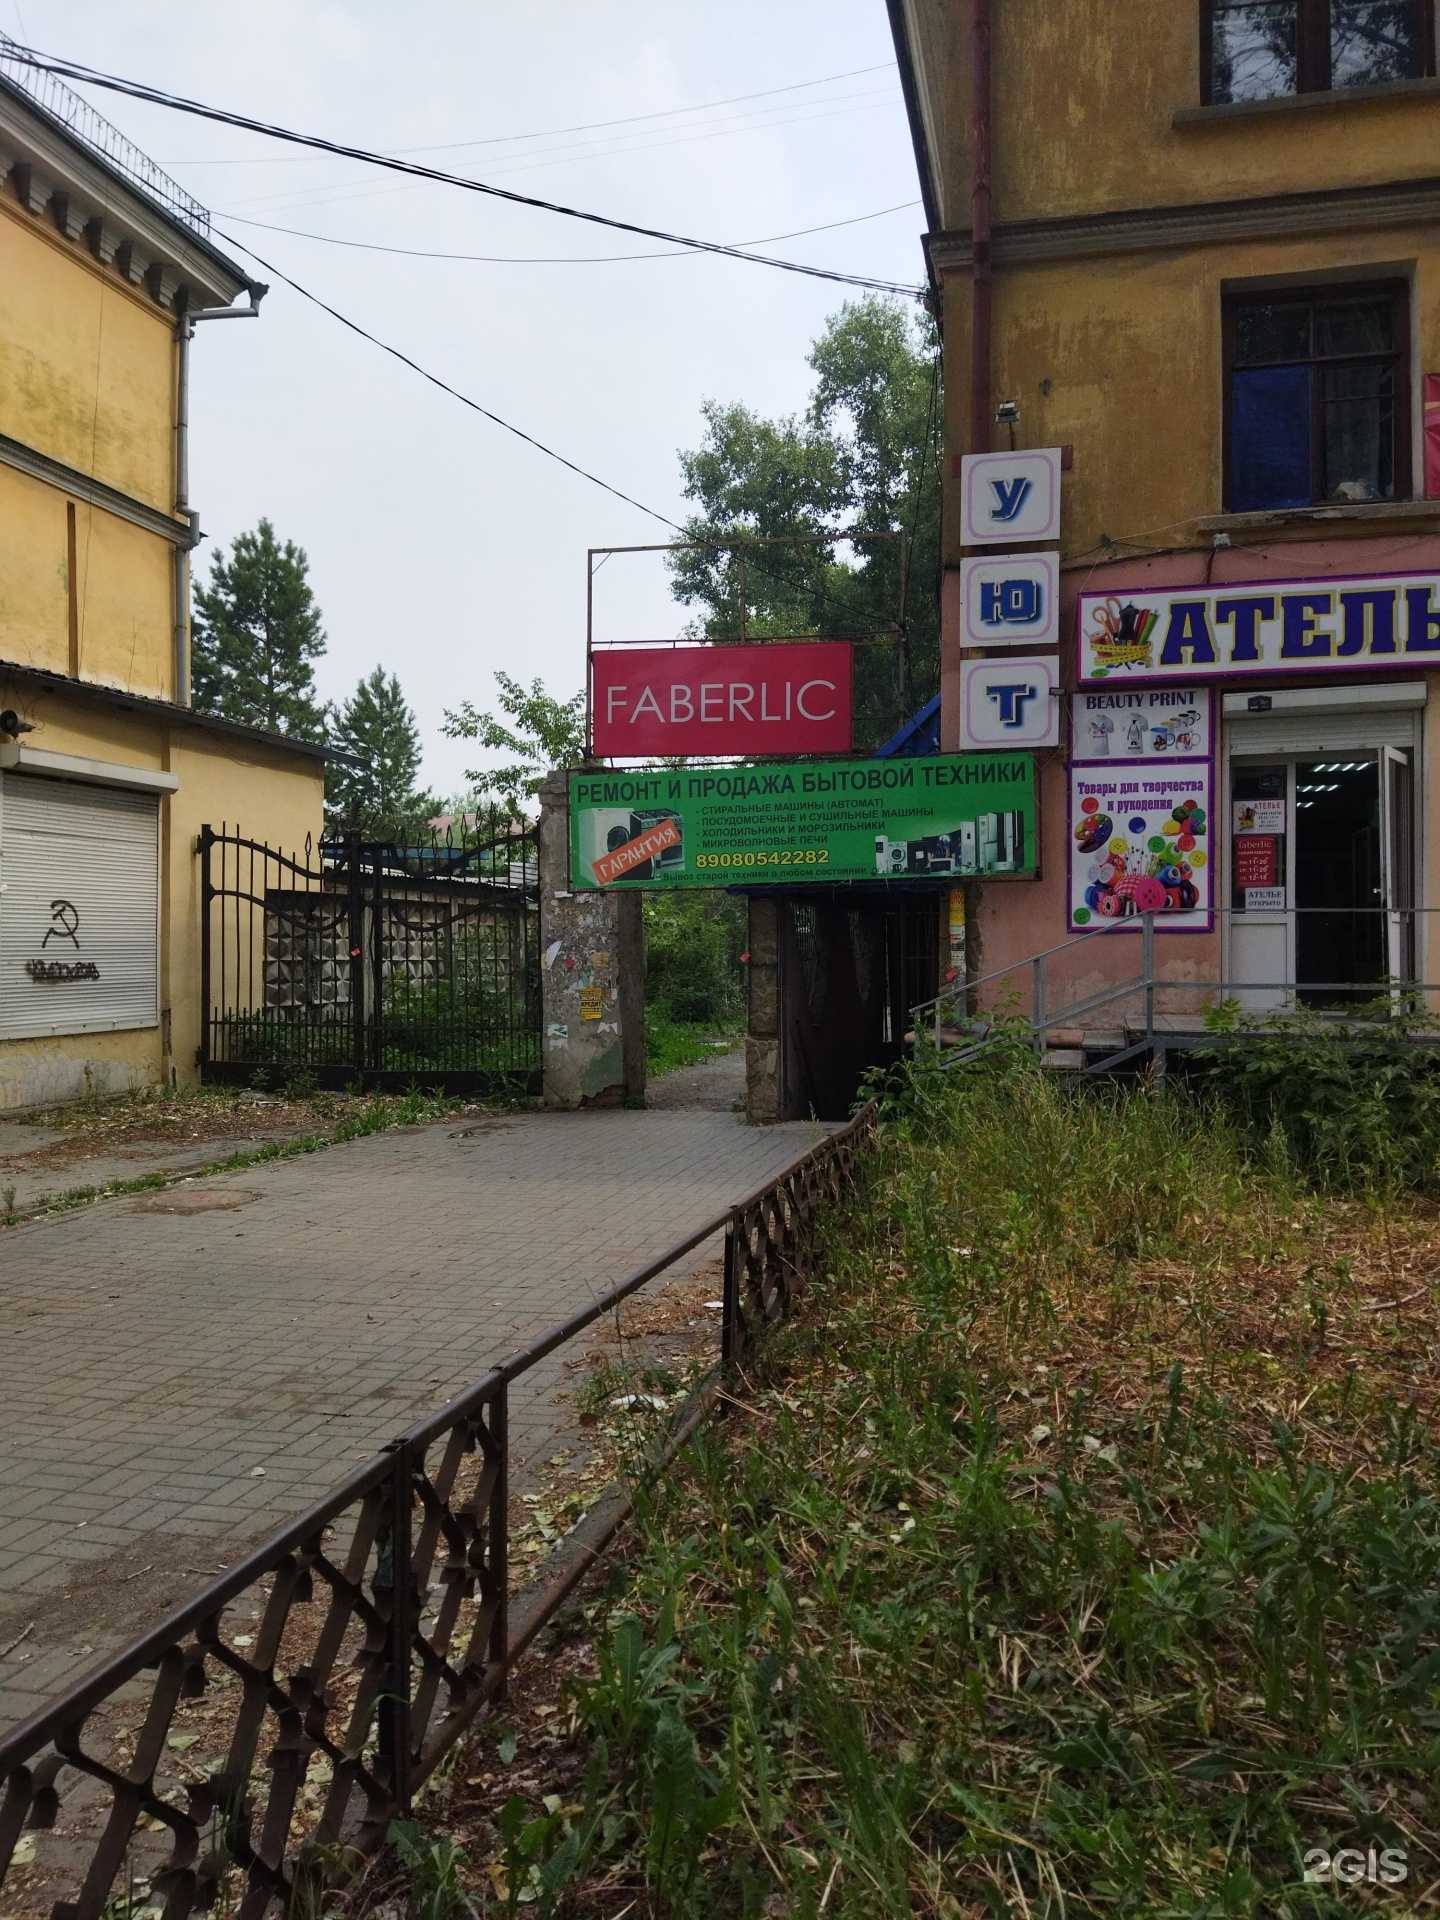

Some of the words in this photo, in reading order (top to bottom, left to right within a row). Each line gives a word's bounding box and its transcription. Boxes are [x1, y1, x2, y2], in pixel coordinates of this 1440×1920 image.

[606, 679, 838, 724] FABERLIC
[1086, 694, 1145, 710] BEAUTY
[1150, 691, 1197, 707] PRINT
[577, 780, 662, 803] РЕМОНТ
[668, 779, 681, 799] И
[688, 774, 795, 800] ПРОДАЖА
[802, 763, 914, 793] БЫТОВОЙ
[921, 761, 1027, 787] ТЕХНИКИ
[1077, 782, 1117, 797] Товары
[1120, 782, 1139, 794] для
[1142, 780, 1204, 795] творчества
[702, 803, 771, 815] СТИРАЛЬНЫЕ
[774, 800, 825, 812] МАШИНЫ
[1117, 800, 1173, 813] рукоделия
[702, 814, 796, 826] ПОСУДОМОЕЧНЫЕ
[800, 812, 806, 821] И
[809, 809, 880, 822] СУШИЛЬНЫЕ
[882, 807, 934, 818] МАШИНЫ
[702, 824, 785, 837] ХОЛОДИЛЬНИКИ
[789, 824, 796, 834] И
[798, 821, 886, 834] МОРОЗИЛЬНИКИ
[702, 836, 796, 848] МИКРОВОЛНОВЫЕ
[800, 834, 828, 845] ПЕЧИ
[600, 827, 677, 878] ГАРАНТИЯ
[696, 850, 829, 868] 89080542282
[1248, 891, 1282, 899] АТЕЛЬЕ
